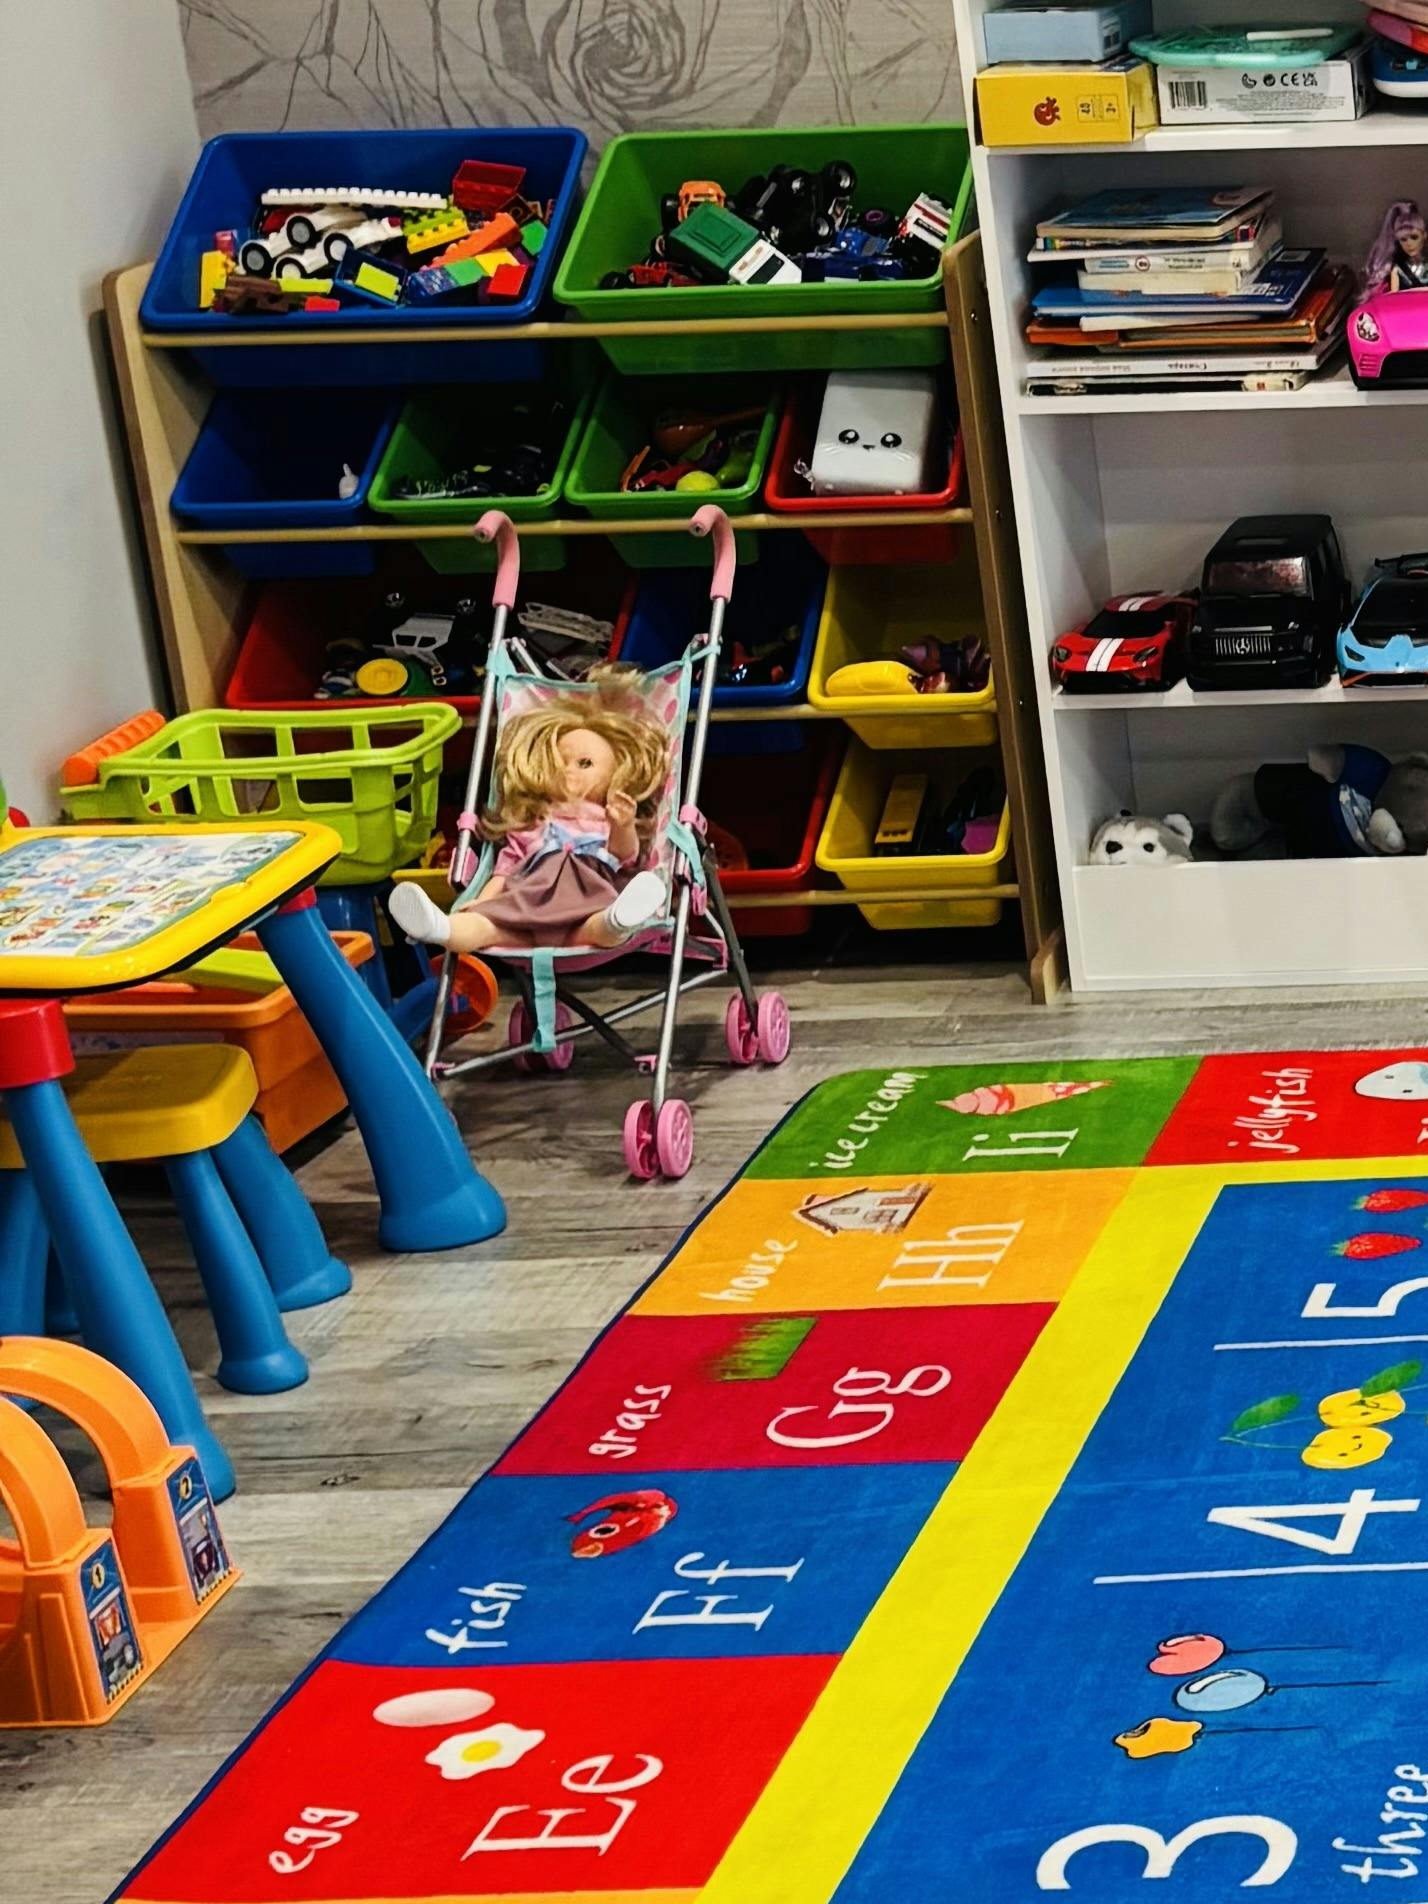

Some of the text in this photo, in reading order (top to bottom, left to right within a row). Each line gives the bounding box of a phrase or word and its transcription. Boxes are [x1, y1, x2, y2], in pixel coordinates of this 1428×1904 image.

[808, 1070, 930, 1170] ice cream
[961, 1127, 1079, 1162] Ii
[1227, 1067, 1318, 1154] jellyfish
[699, 1239, 798, 1303] house
[877, 1220, 1024, 1291] Hh
[588, 1384, 672, 1459] grass
[766, 1365, 952, 1449] Gg
[1206, 1488, 1421, 1555] 4
[425, 1582, 527, 1655] fish
[632, 1551, 805, 1634] Ff
[268, 1806, 360, 1874] egg
[459, 1752, 665, 1863] Ee
[1035, 1814, 1298, 1890] 3
